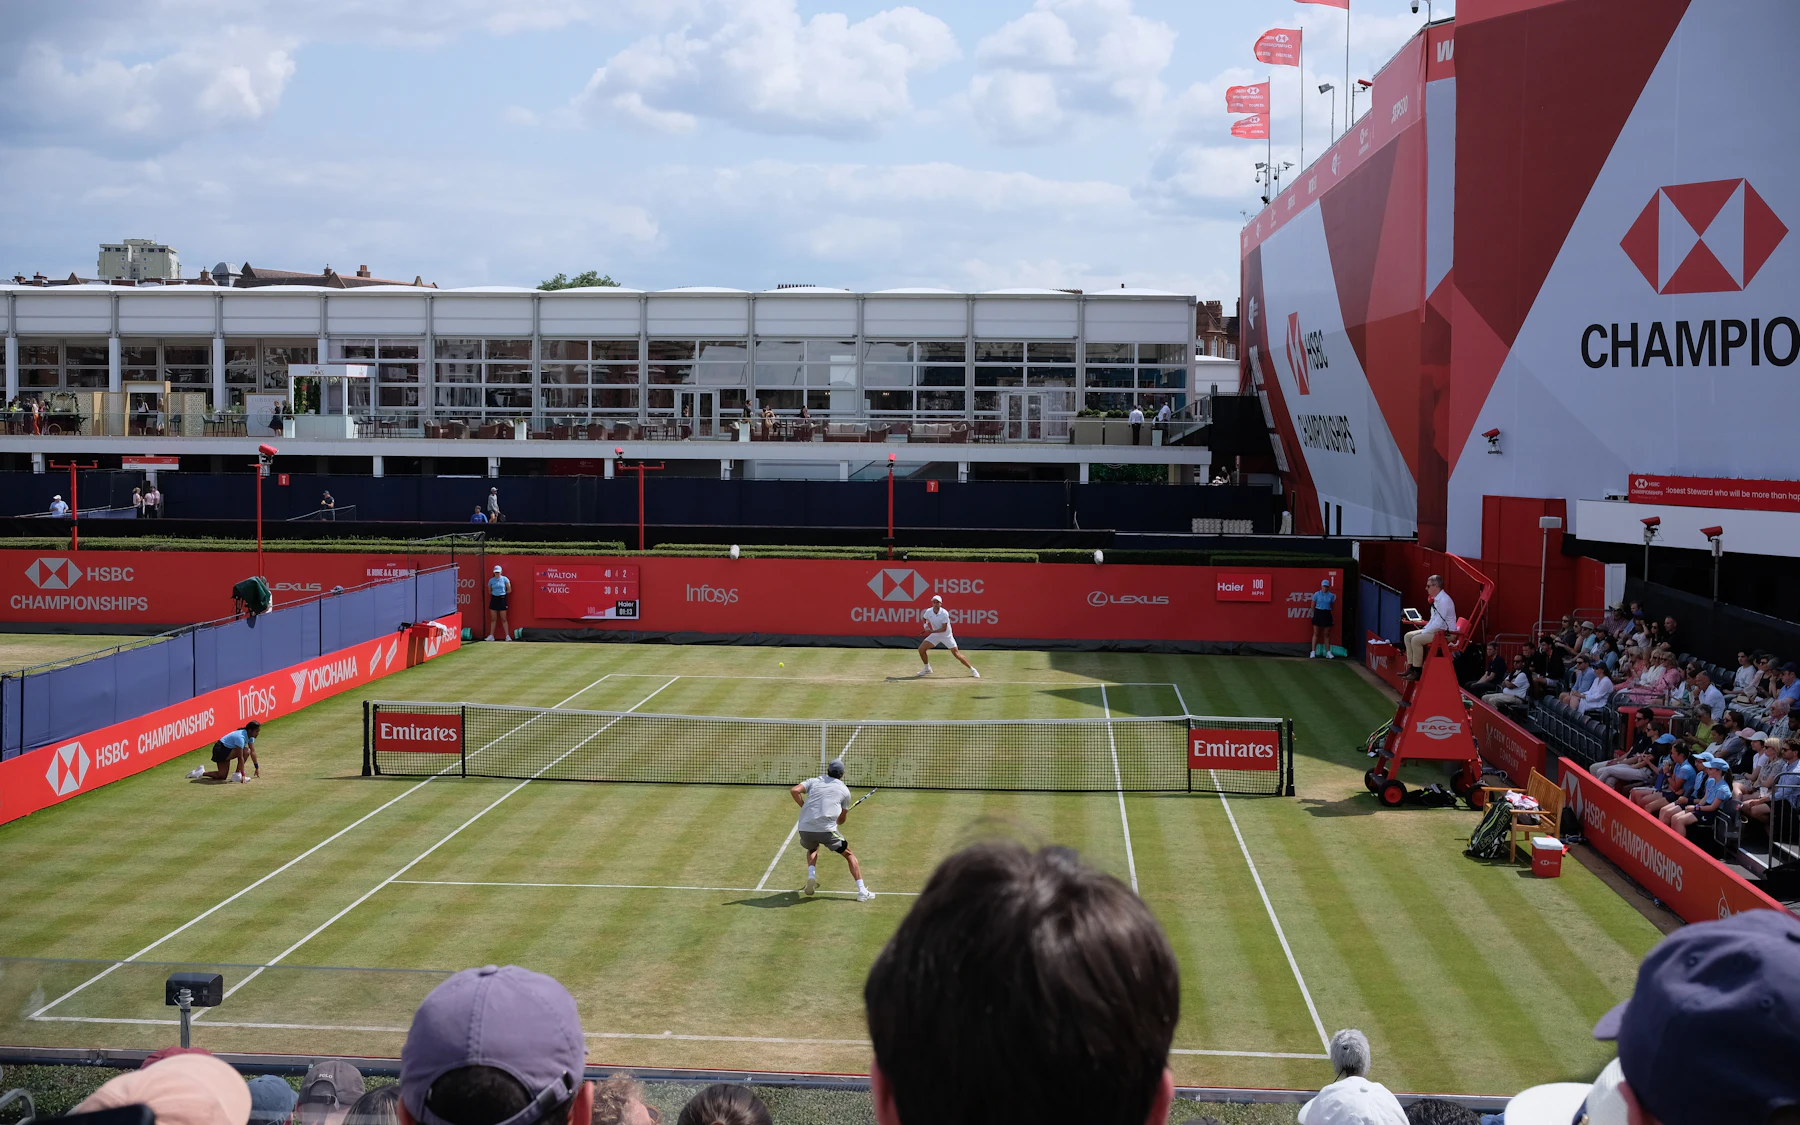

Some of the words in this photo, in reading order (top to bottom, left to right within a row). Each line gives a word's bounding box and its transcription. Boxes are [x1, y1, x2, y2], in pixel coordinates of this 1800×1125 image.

[1305, 329, 1328, 371] HSBC
[1581, 316, 1800, 369] CHAMPIO
[1298, 415, 1355, 455] CHAMPIONSHIPS
[1687, 488, 1713, 496] Steward
[87, 567, 134, 582] HSBC
[1252, 579, 1264, 589] 100
[266, 582, 322, 592] LEXUS
[604, 586, 611, 594] 30
[615, 586, 619, 594] 6
[623, 586, 627, 594] 4
[686, 584, 739, 606] Infosys
[934, 579, 984, 594] HSBC
[1217, 582, 1244, 591] Haier
[10, 595, 148, 611] CHAMPIONSHIPS
[1110, 595, 1169, 604] LEXUS
[851, 607, 999, 624] CHAMPISHIPS
[307, 656, 358, 693] YOKOHAMA
[237, 685, 277, 720] Infosys
[95, 739, 129, 769] HSBC
[137, 707, 215, 754] CHAMPIONSHIPS
[380, 723, 457, 742] Emirates
[1193, 739, 1274, 758] Emirates
[1493, 728, 1506, 744] CREW
[1505, 737, 1527, 761] CLOTHING
[1584, 799, 1606, 834] HSBC
[1610, 819, 1683, 892] CHAMPIONSHIPS
